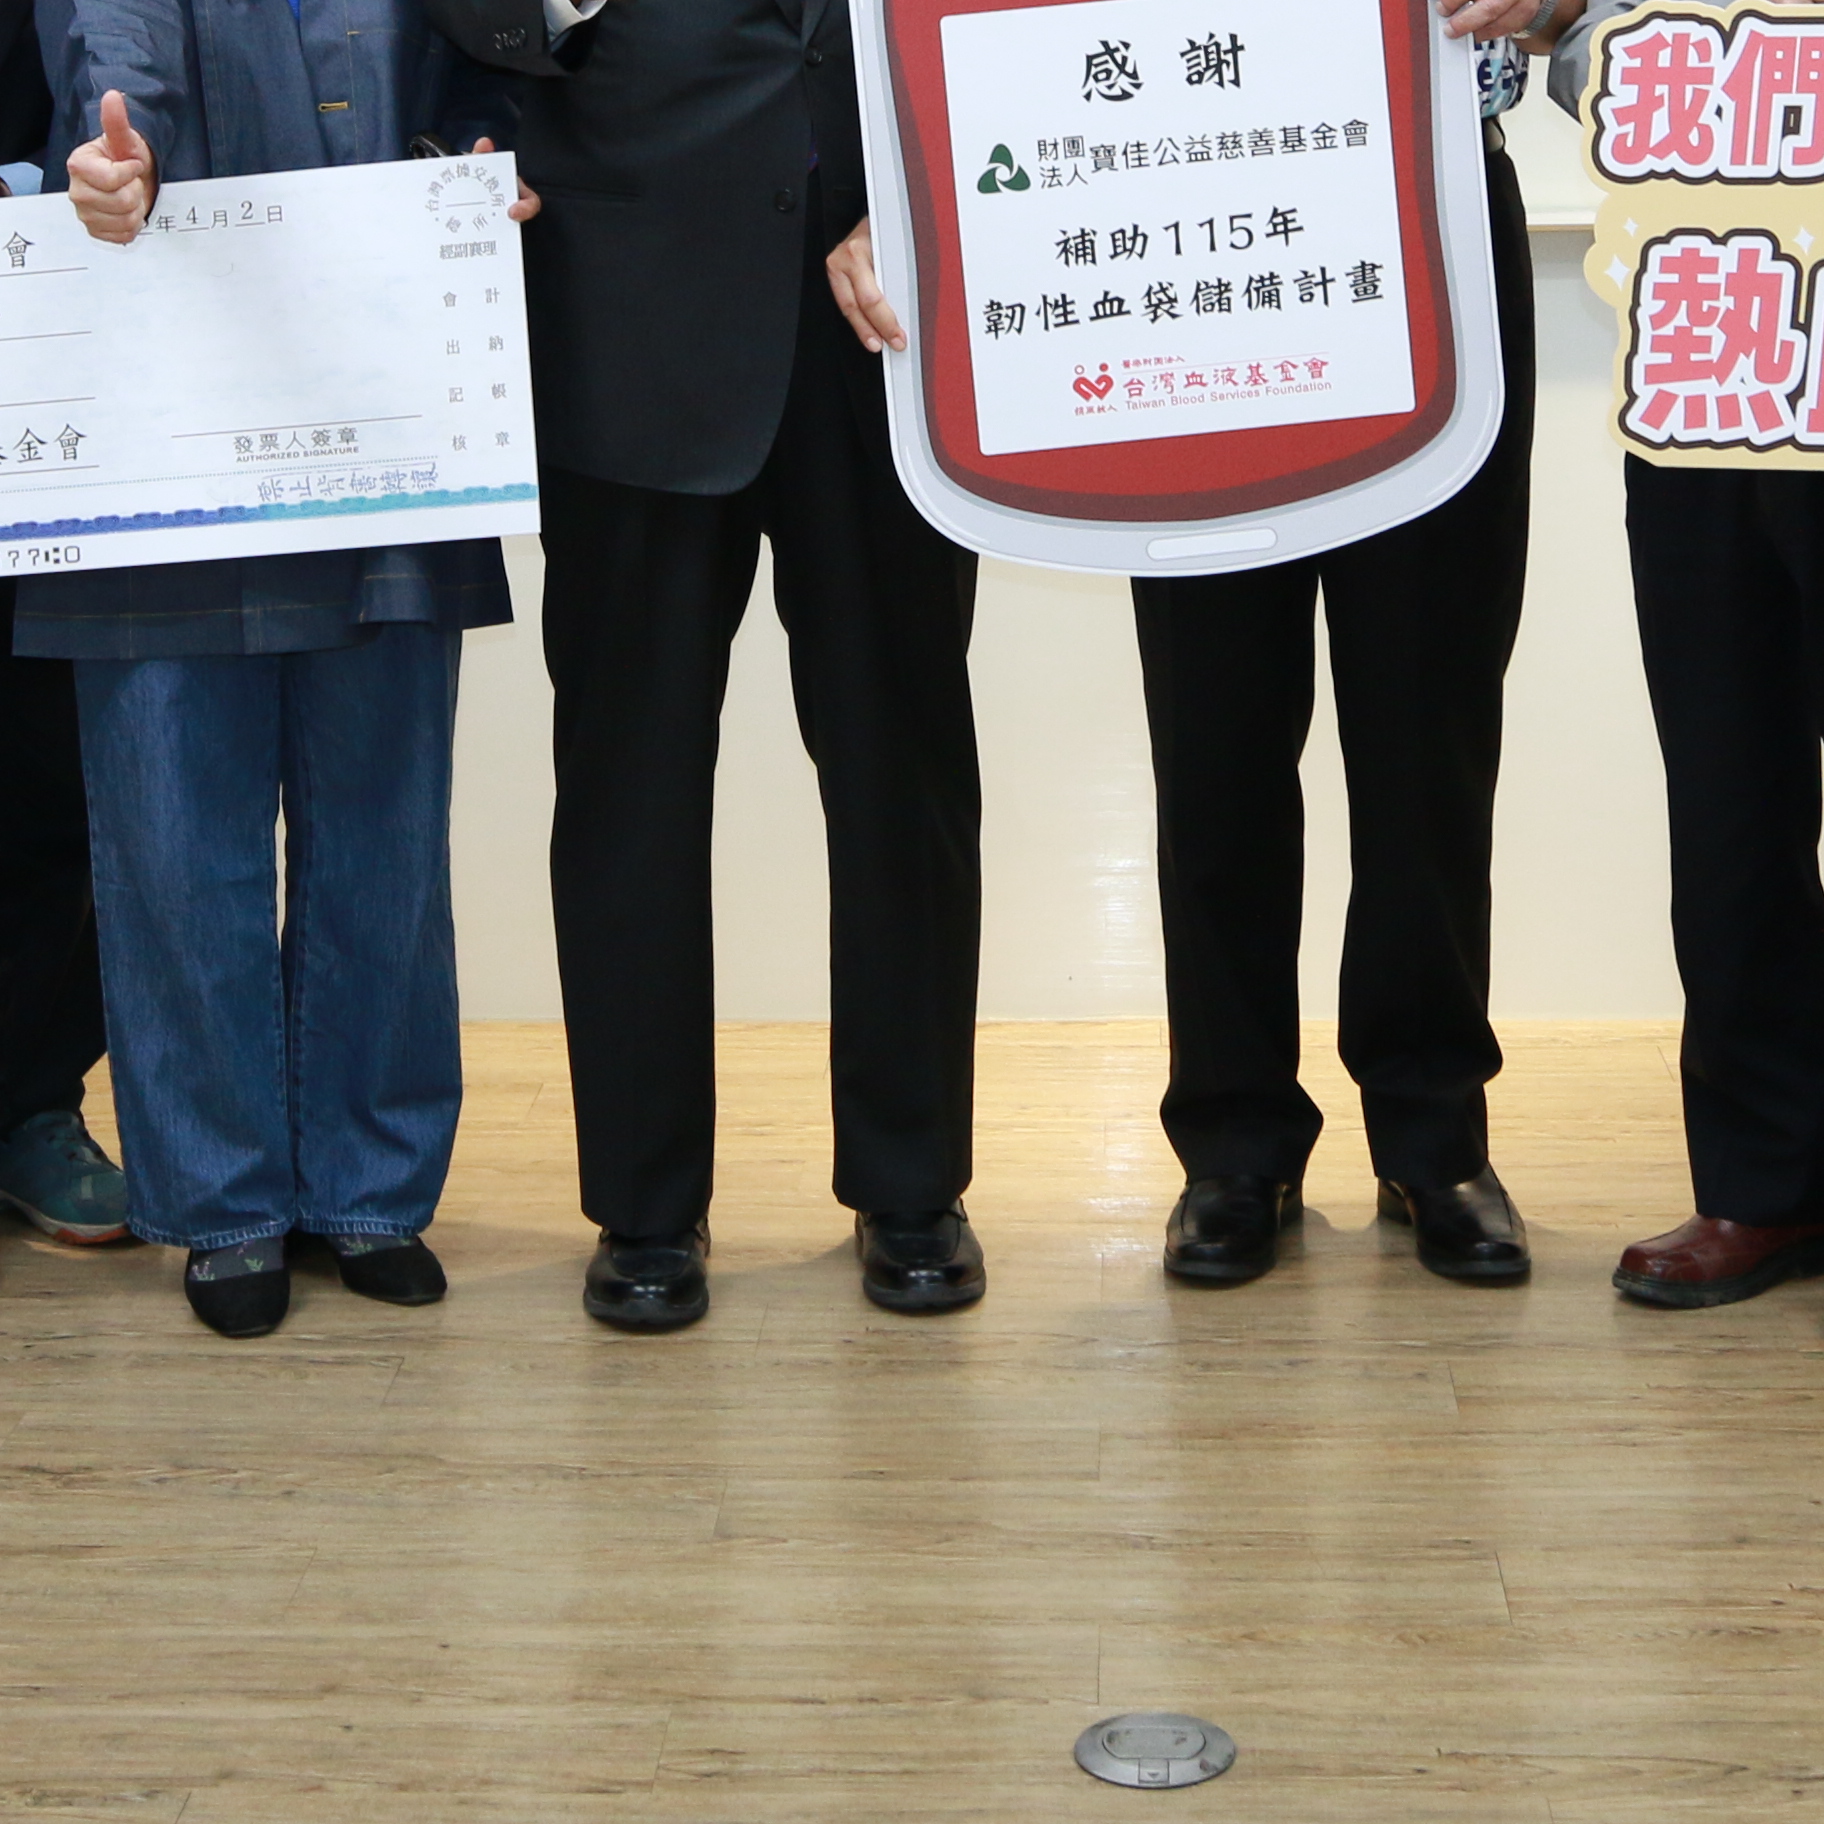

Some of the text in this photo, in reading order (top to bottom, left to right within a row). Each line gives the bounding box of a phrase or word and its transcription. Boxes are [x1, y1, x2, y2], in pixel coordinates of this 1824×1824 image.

[1081, 31, 1246, 103] 感謝
[1037, 135, 1085, 162] 財團
[1088, 118, 1370, 173] 寶佳公益慈善基金會
[1039, 163, 1089, 190] 法人
[1054, 205, 1305, 267] 補助115年
[982, 260, 1385, 339] 韌性血袋儲備計畫
[1123, 356, 1329, 399] 台灣血液基金會
[1125, 381, 1332, 411] Taiwan Blood Services Foundation
[236, 446, 360, 463] AUTHORIZED SIGNATURE
